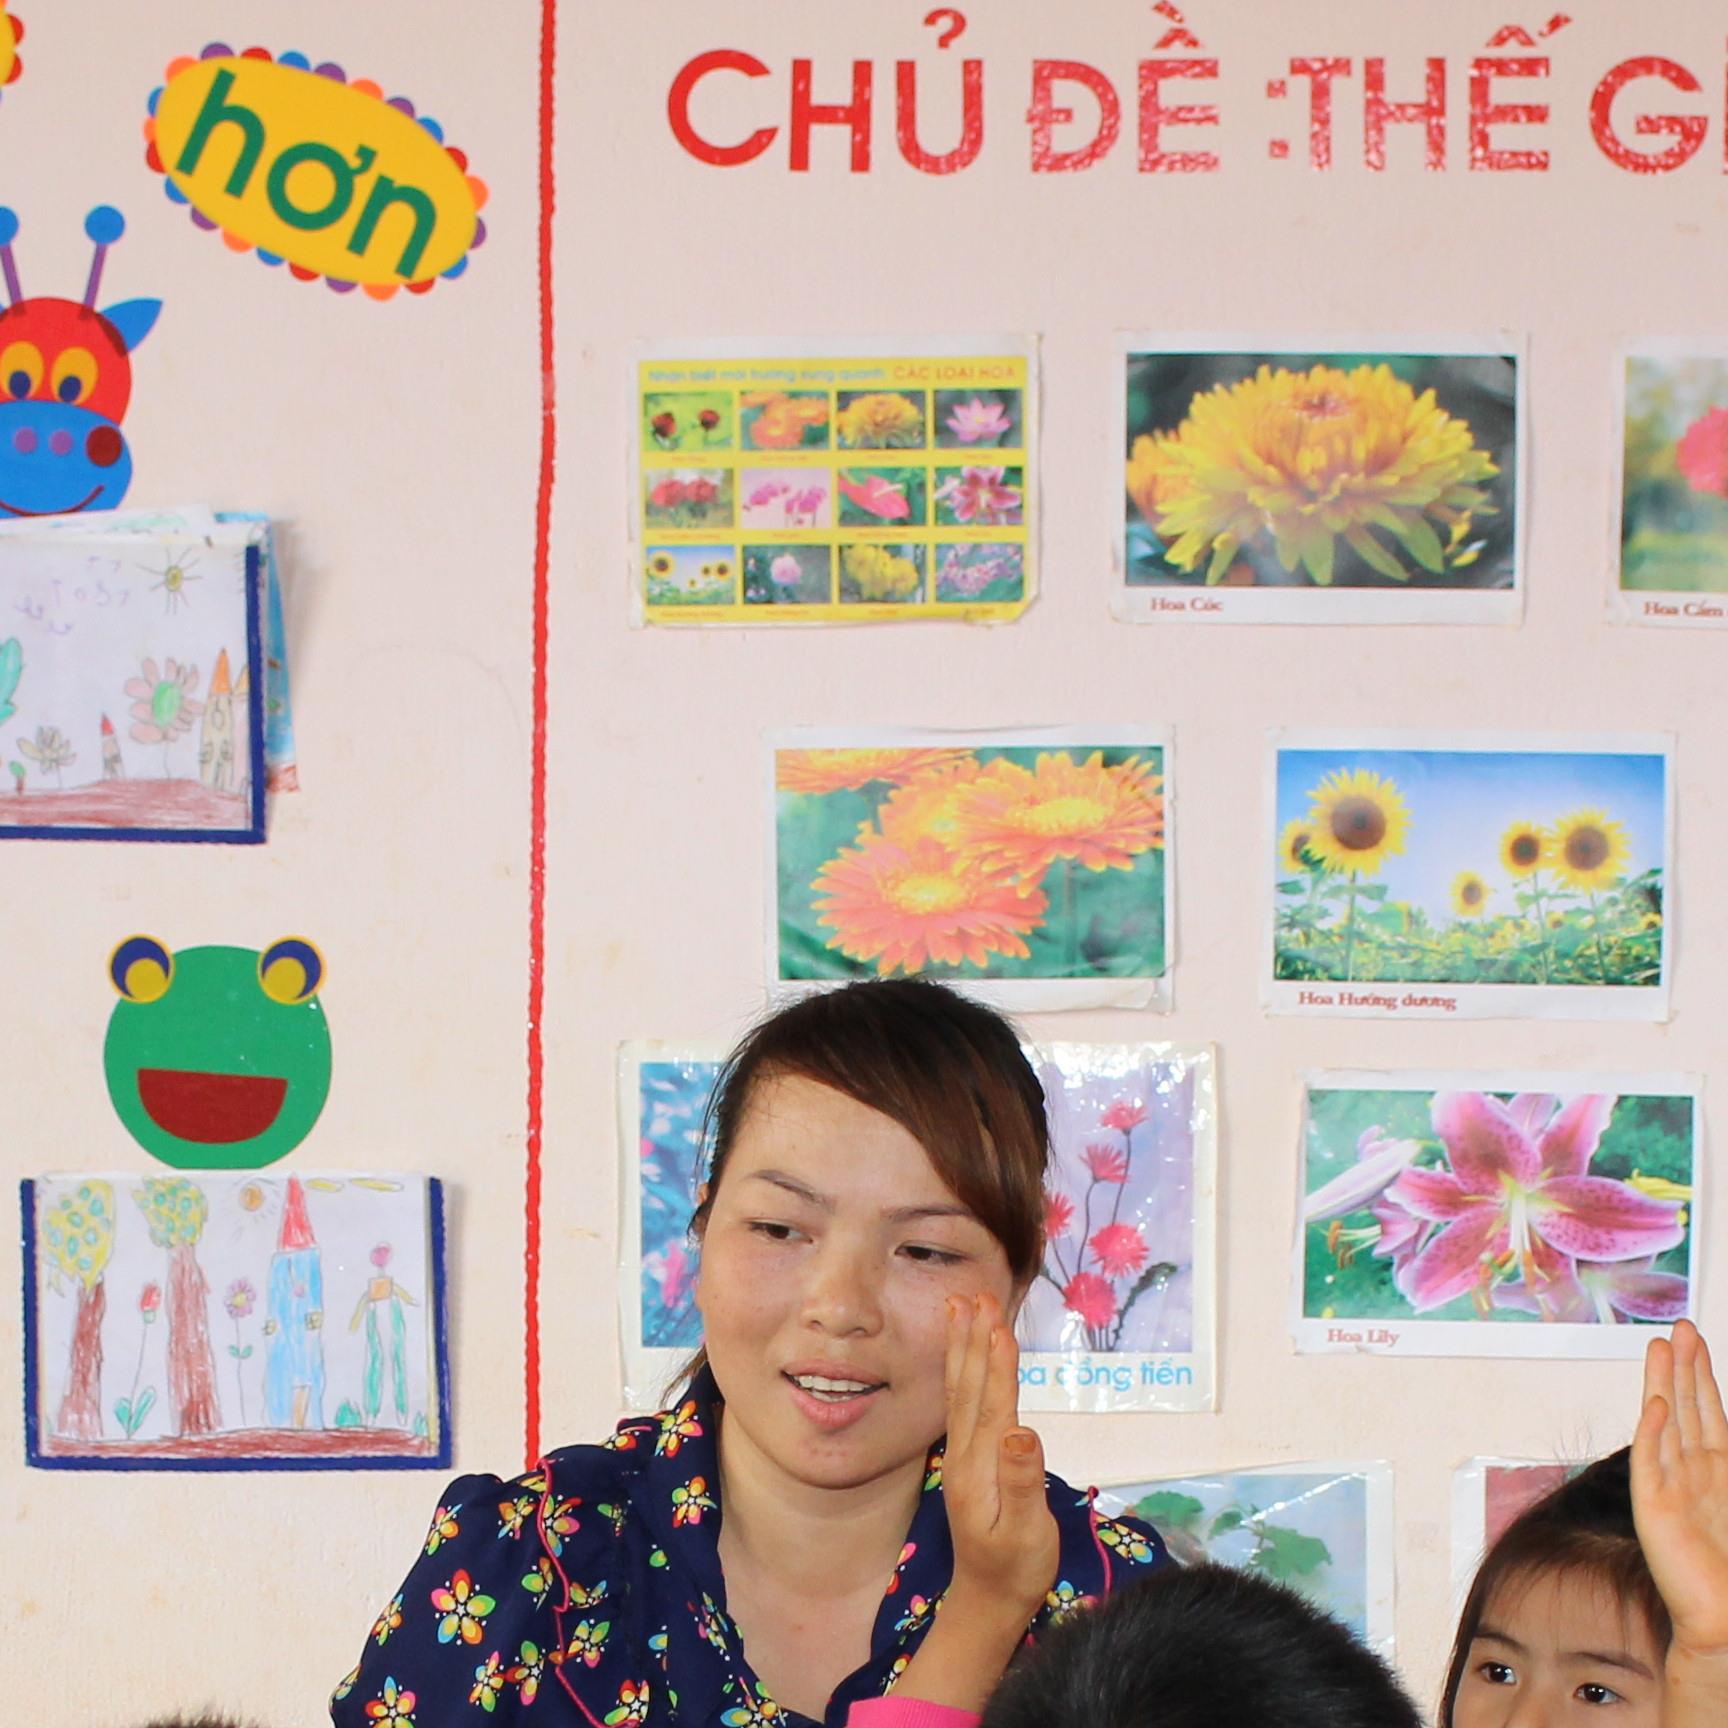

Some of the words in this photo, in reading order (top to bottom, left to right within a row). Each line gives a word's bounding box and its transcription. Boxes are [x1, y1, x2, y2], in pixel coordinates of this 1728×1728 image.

[667, 8, 984, 175] CHỦ
[1026, 0, 1219, 173] ĐỀ
[175, 69, 437, 281] hơn
[1151, 597, 1185, 611] Hoa
[1644, 602, 1678, 616] Hoa
[1299, 992, 1333, 1005] Hoa
[1328, 1329, 1362, 1343] Hoa
[1367, 1330, 1400, 1348] Lily
